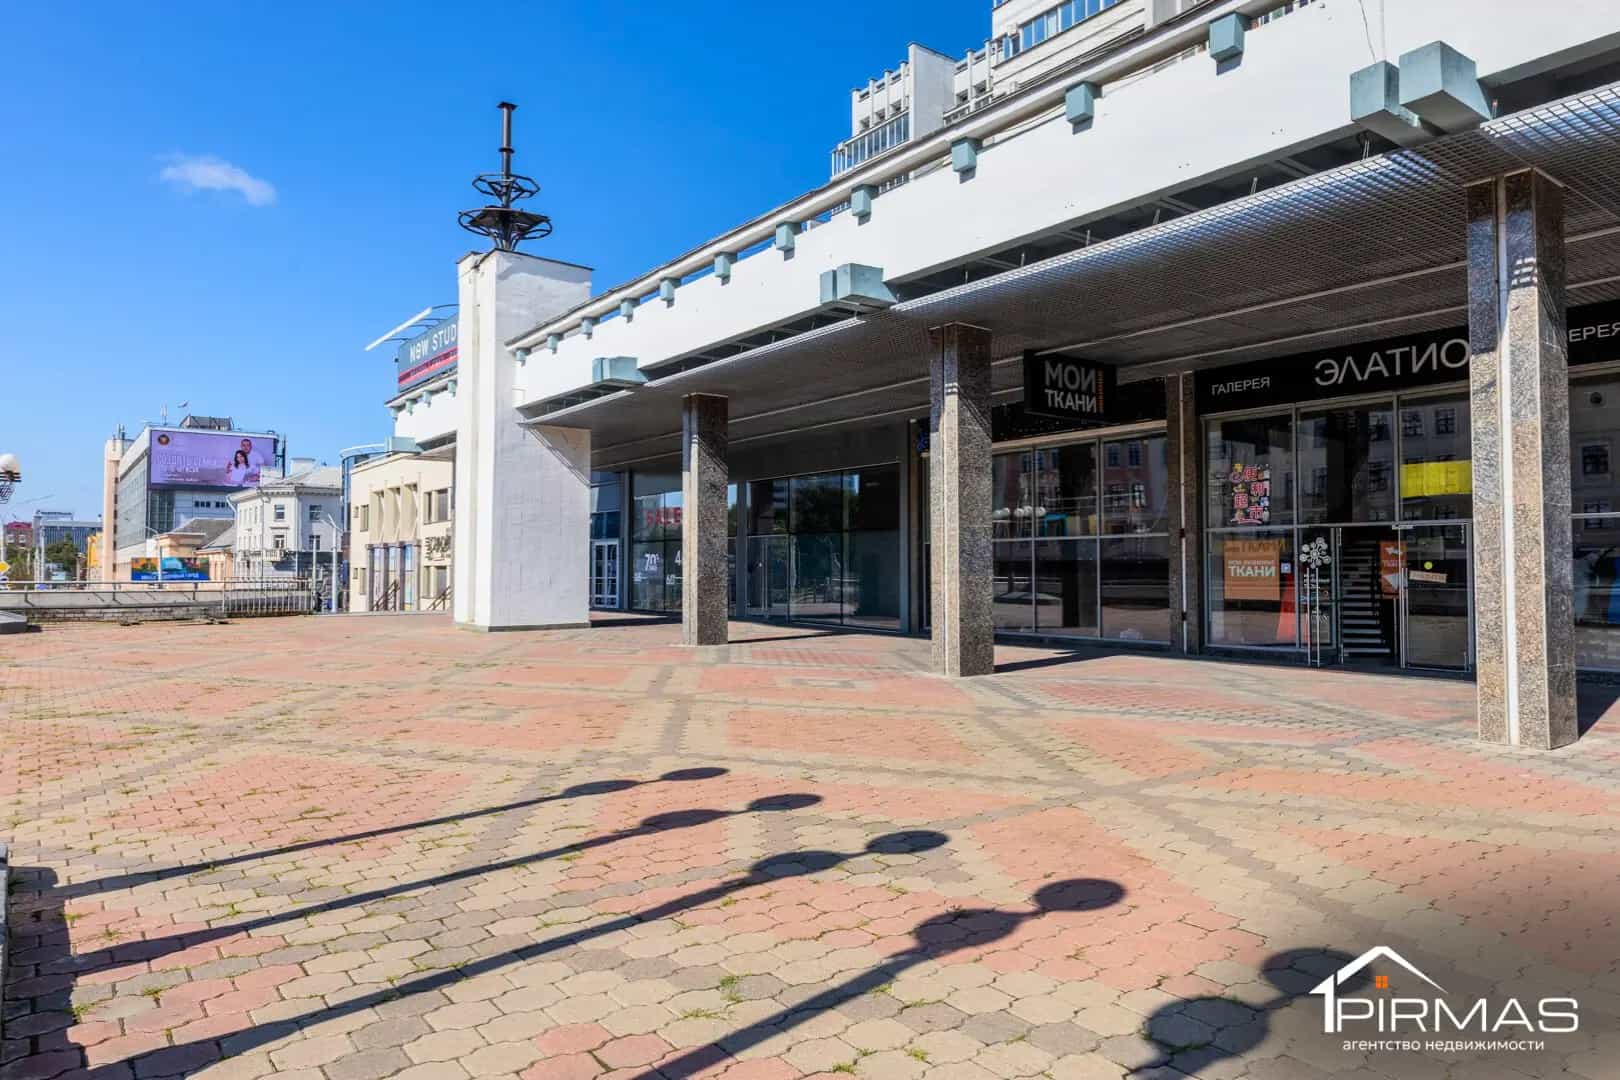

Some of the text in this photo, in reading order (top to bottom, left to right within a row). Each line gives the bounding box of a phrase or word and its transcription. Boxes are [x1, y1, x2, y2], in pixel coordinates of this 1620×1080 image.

[432, 323, 457, 351] STUD
[1314, 338, 1470, 386] ЭЛАТИО
[1044, 360, 1096, 393] МОИ
[1211, 376, 1271, 396] ГАЛЕРЕЯ
[1044, 388, 1097, 413] ТКАНИ
[1228, 565, 1276, 577] ТКАНИ
